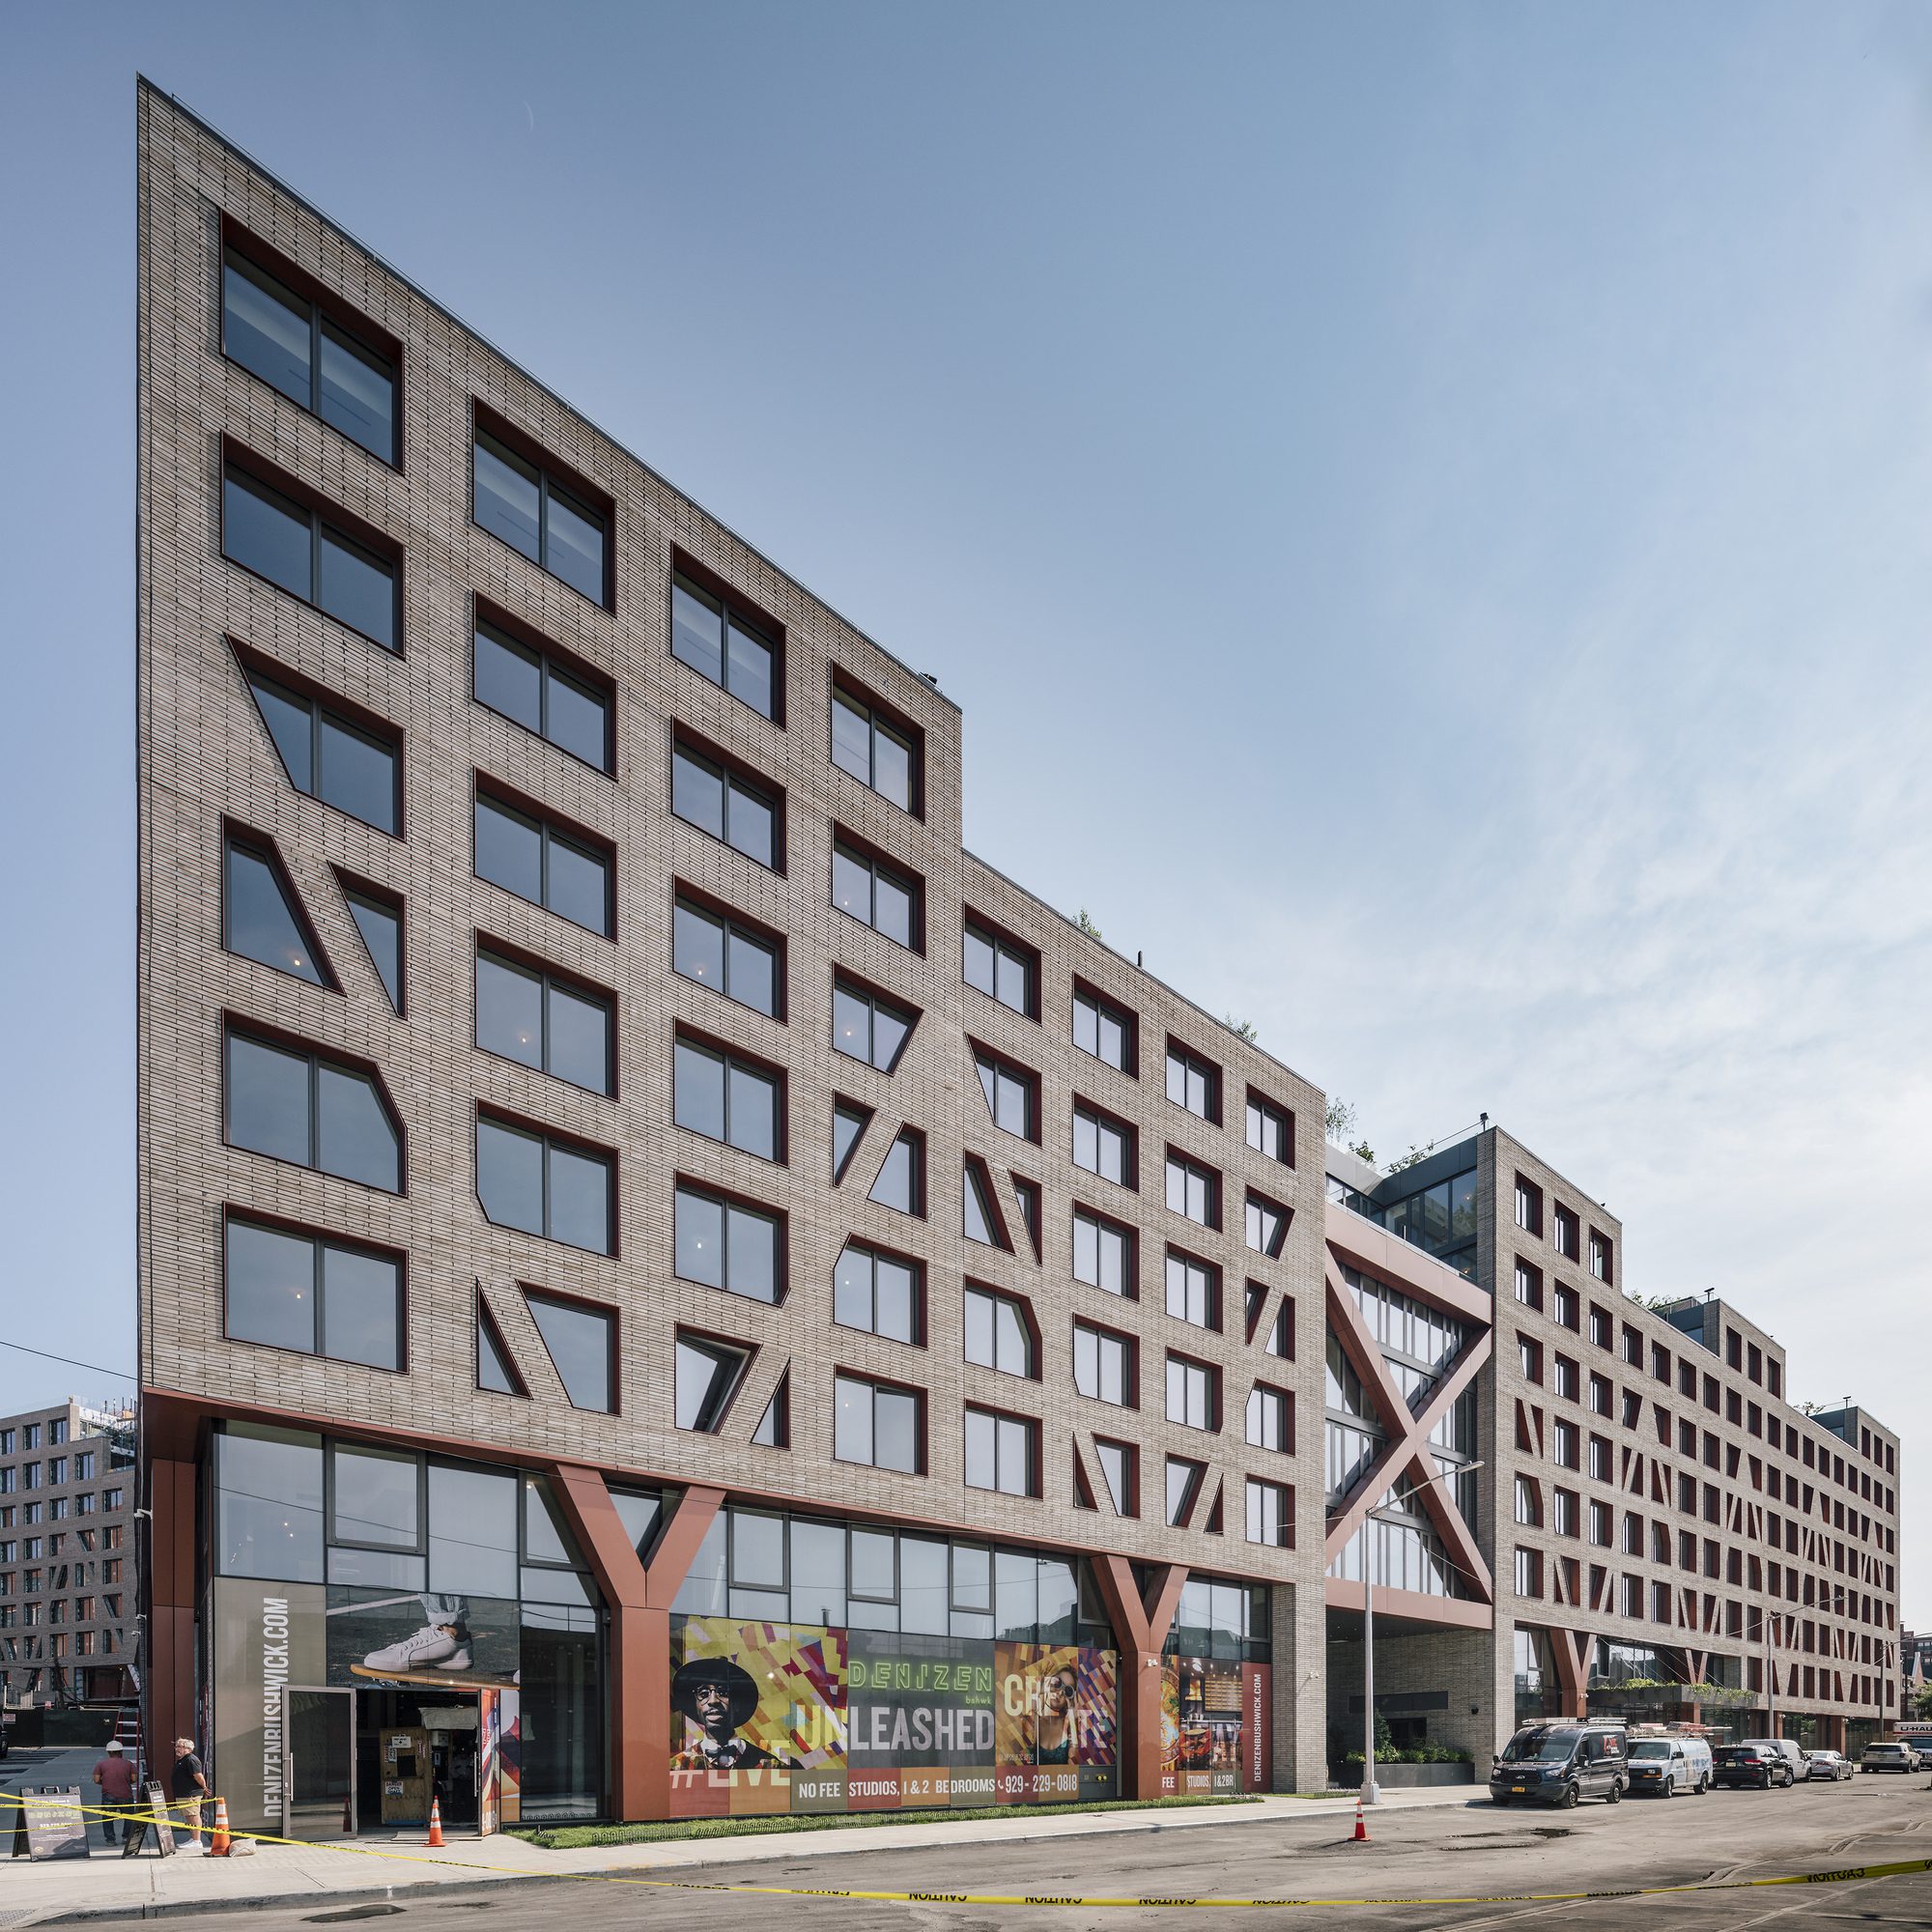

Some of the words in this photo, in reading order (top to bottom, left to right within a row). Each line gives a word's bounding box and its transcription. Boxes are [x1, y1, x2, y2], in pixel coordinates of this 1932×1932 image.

[848, 1661, 992, 1691] DENIZEN
[264, 1598, 288, 1817] DENIZENBUSHWICK.COM
[966, 1695, 992, 1705] bshwk
[796, 1704, 994, 1750] UNLEASHED
[799, 1783, 816, 1798] NO
[819, 1782, 840, 1797] FEE
[848, 1780, 899, 1797] STUDIOS,
[910, 1781, 920, 1794] &
[923, 1780, 928, 1794] 2
[935, 1778, 995, 1793] BEDROOMS
[1162, 1776, 1175, 1788] FEE
